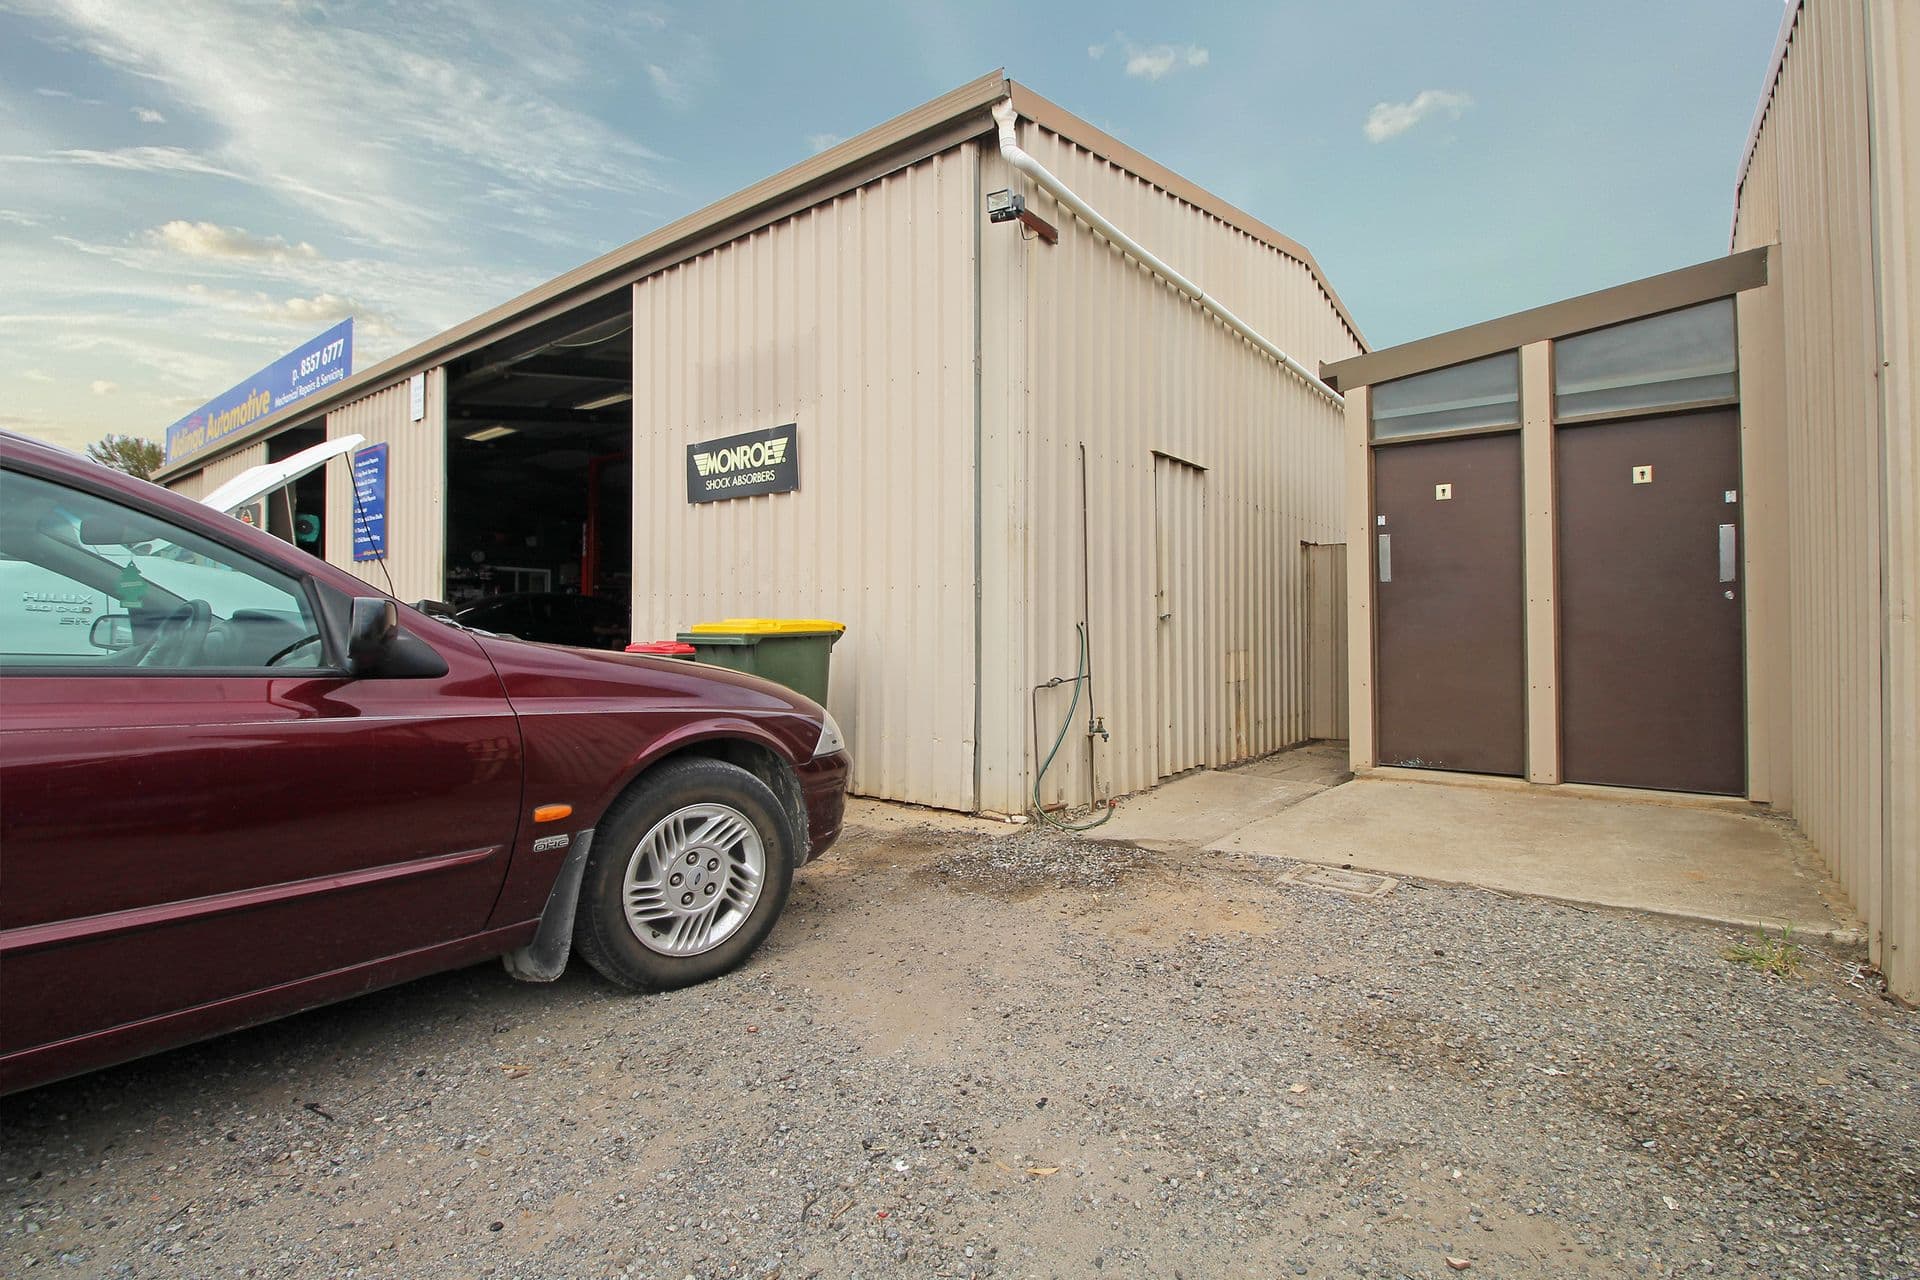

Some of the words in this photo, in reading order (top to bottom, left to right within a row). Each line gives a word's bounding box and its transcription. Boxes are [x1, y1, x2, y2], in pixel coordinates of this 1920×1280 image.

[301, 351, 321, 377] 8557
[322, 338, 345, 365] 6777
[299, 379, 316, 397] Repairs
[316, 376, 321, 388] &
[321, 366, 344, 386] Servicing
[207, 388, 270, 442] Automotive
[693, 437, 788, 477] MONROE
[705, 476, 731, 491] SHOCK
[732, 470, 776, 486] ABSORBERS
[23, 591, 93, 605] HILUX
